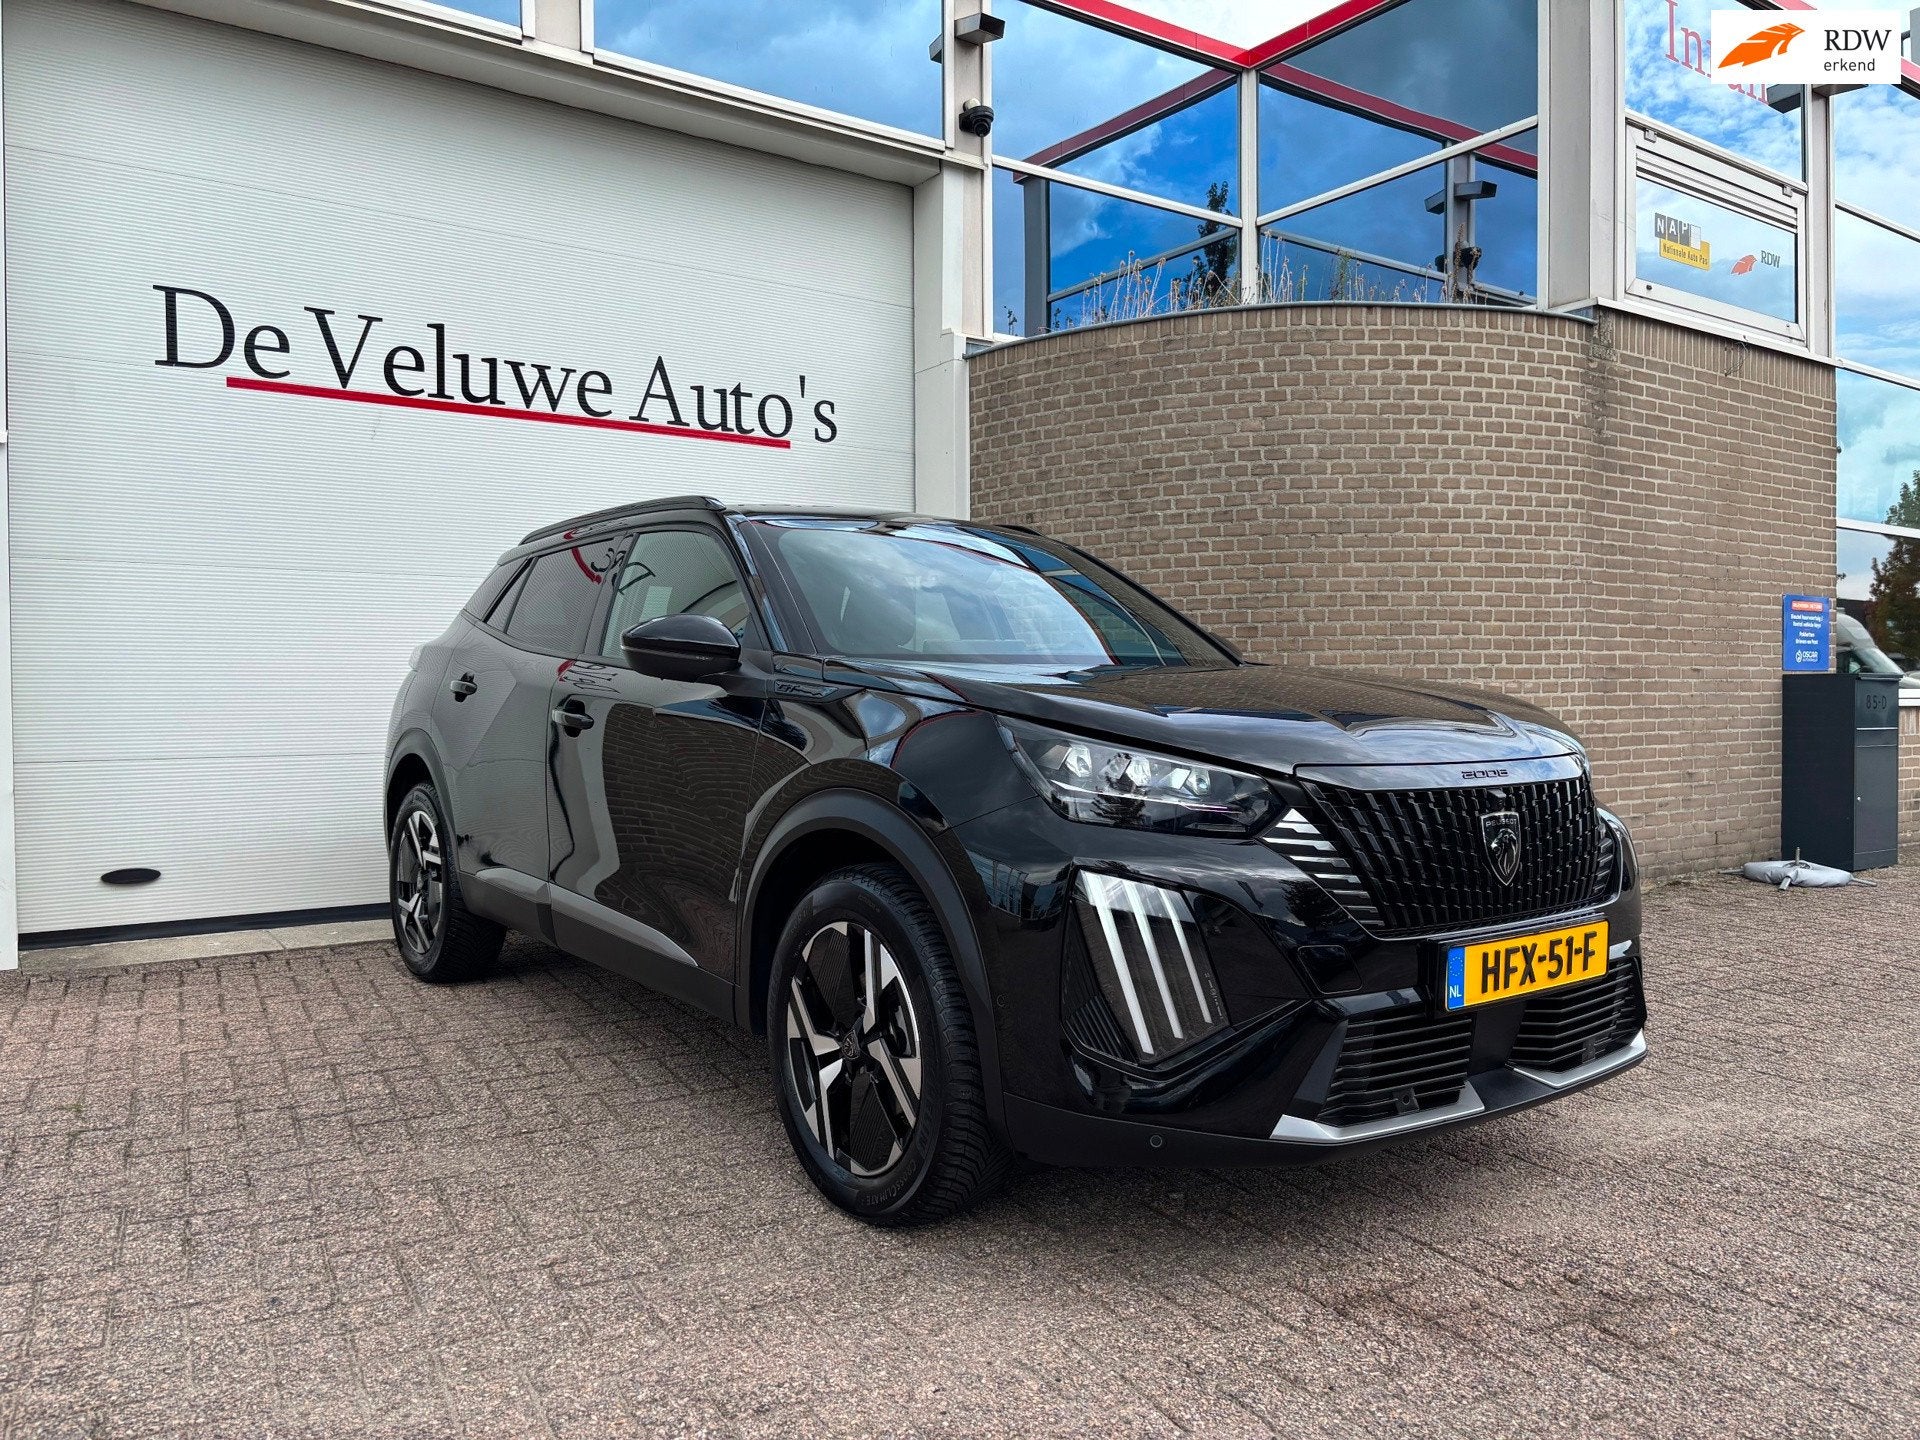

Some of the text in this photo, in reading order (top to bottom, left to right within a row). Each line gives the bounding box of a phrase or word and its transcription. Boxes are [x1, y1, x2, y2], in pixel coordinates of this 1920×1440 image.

[1656, 217, 1689, 236] NAP
[1662, 243, 1687, 259] Nationale
[1687, 250, 1698, 263] Auto
[1760, 250, 1780, 269] RDW
[153, 284, 839, 443] De Veluwe Auto's
[1866, 694, 1887, 710] 85-D
[1485, 818, 1517, 828] PEUGEOT
[1481, 930, 1598, 995] HFX-51-F
[1449, 985, 1462, 998] NL
